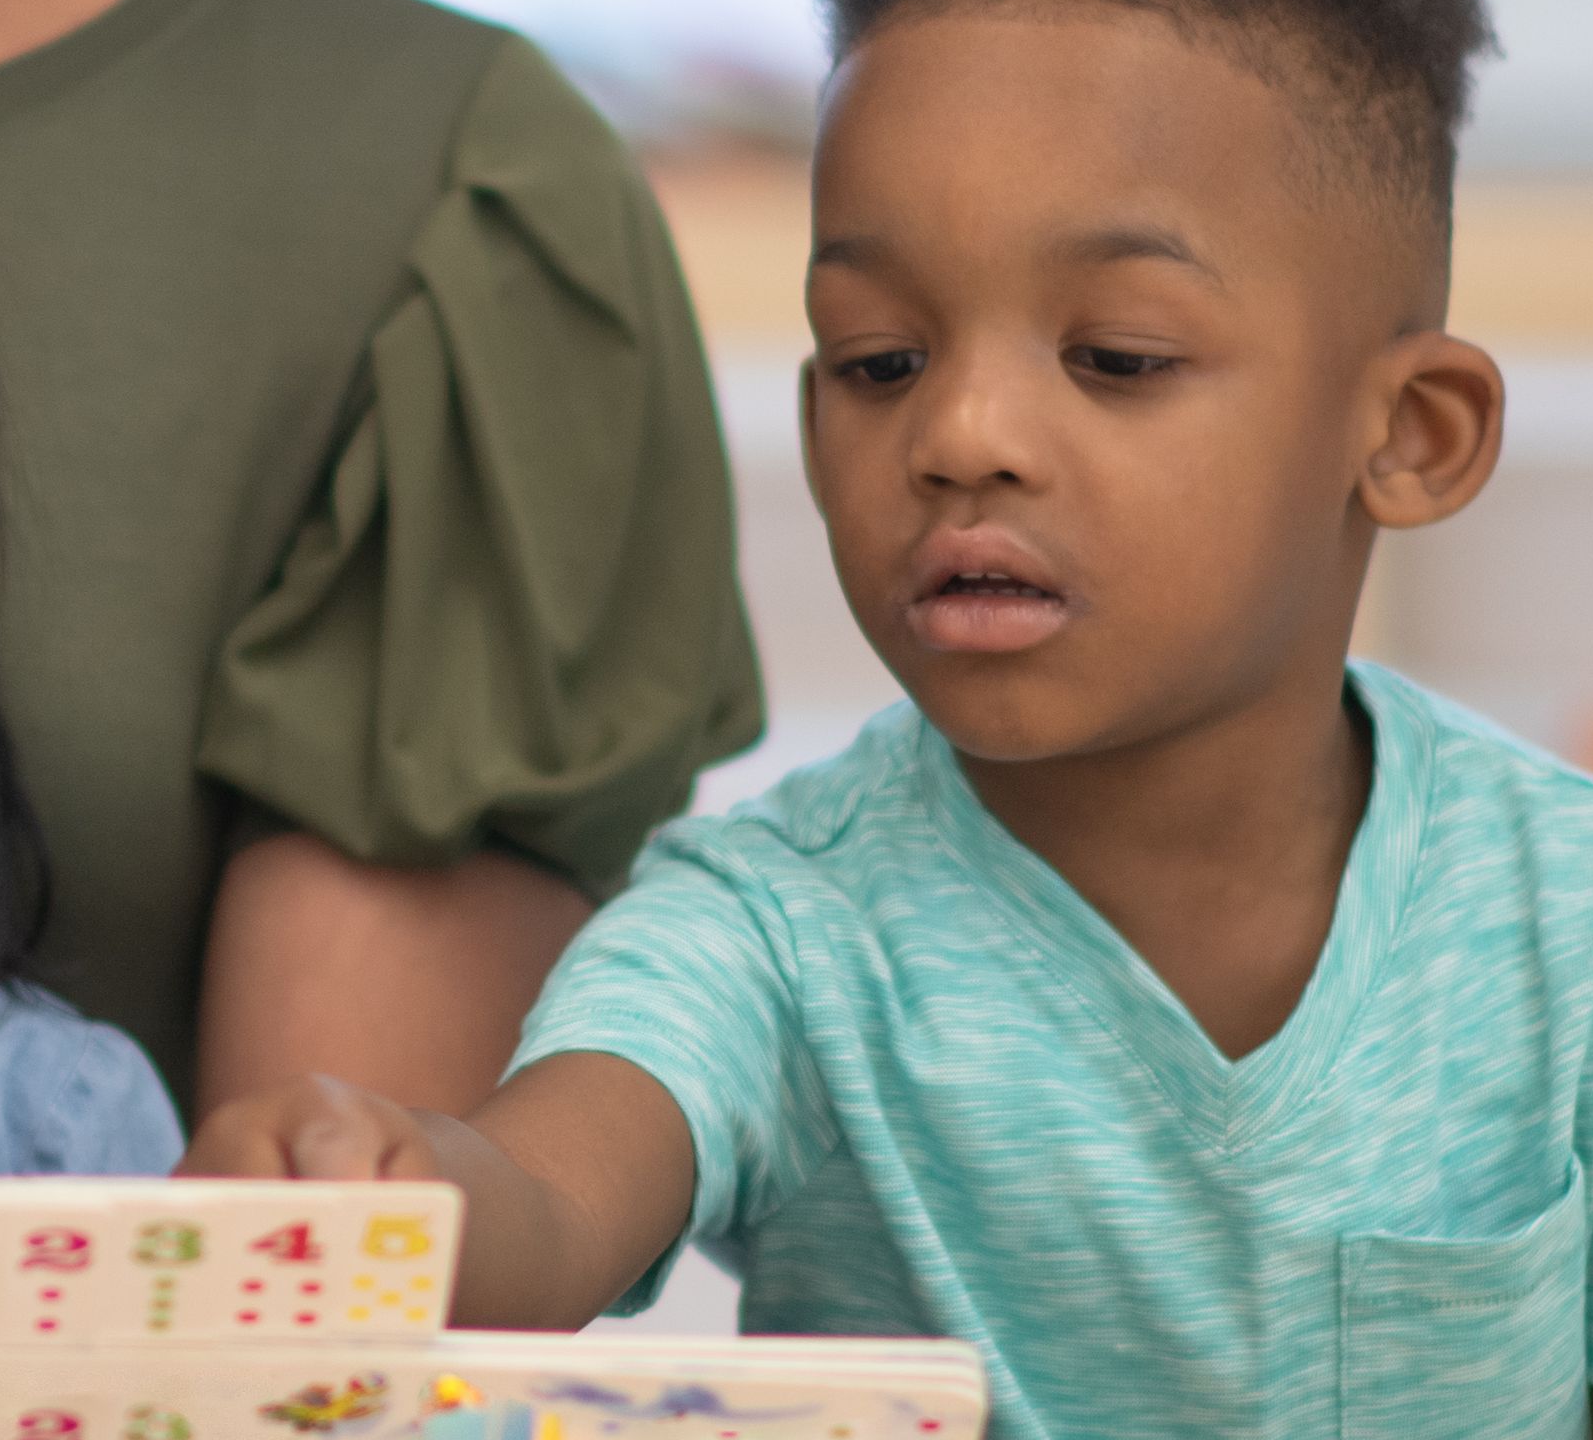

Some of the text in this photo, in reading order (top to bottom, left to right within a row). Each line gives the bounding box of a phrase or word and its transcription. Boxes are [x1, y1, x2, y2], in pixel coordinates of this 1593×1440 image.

[19, 1227, 94, 1271] 2
[131, 1219, 204, 1268] 3
[246, 1222, 323, 1264] 4
[361, 1216, 431, 1258] 5
